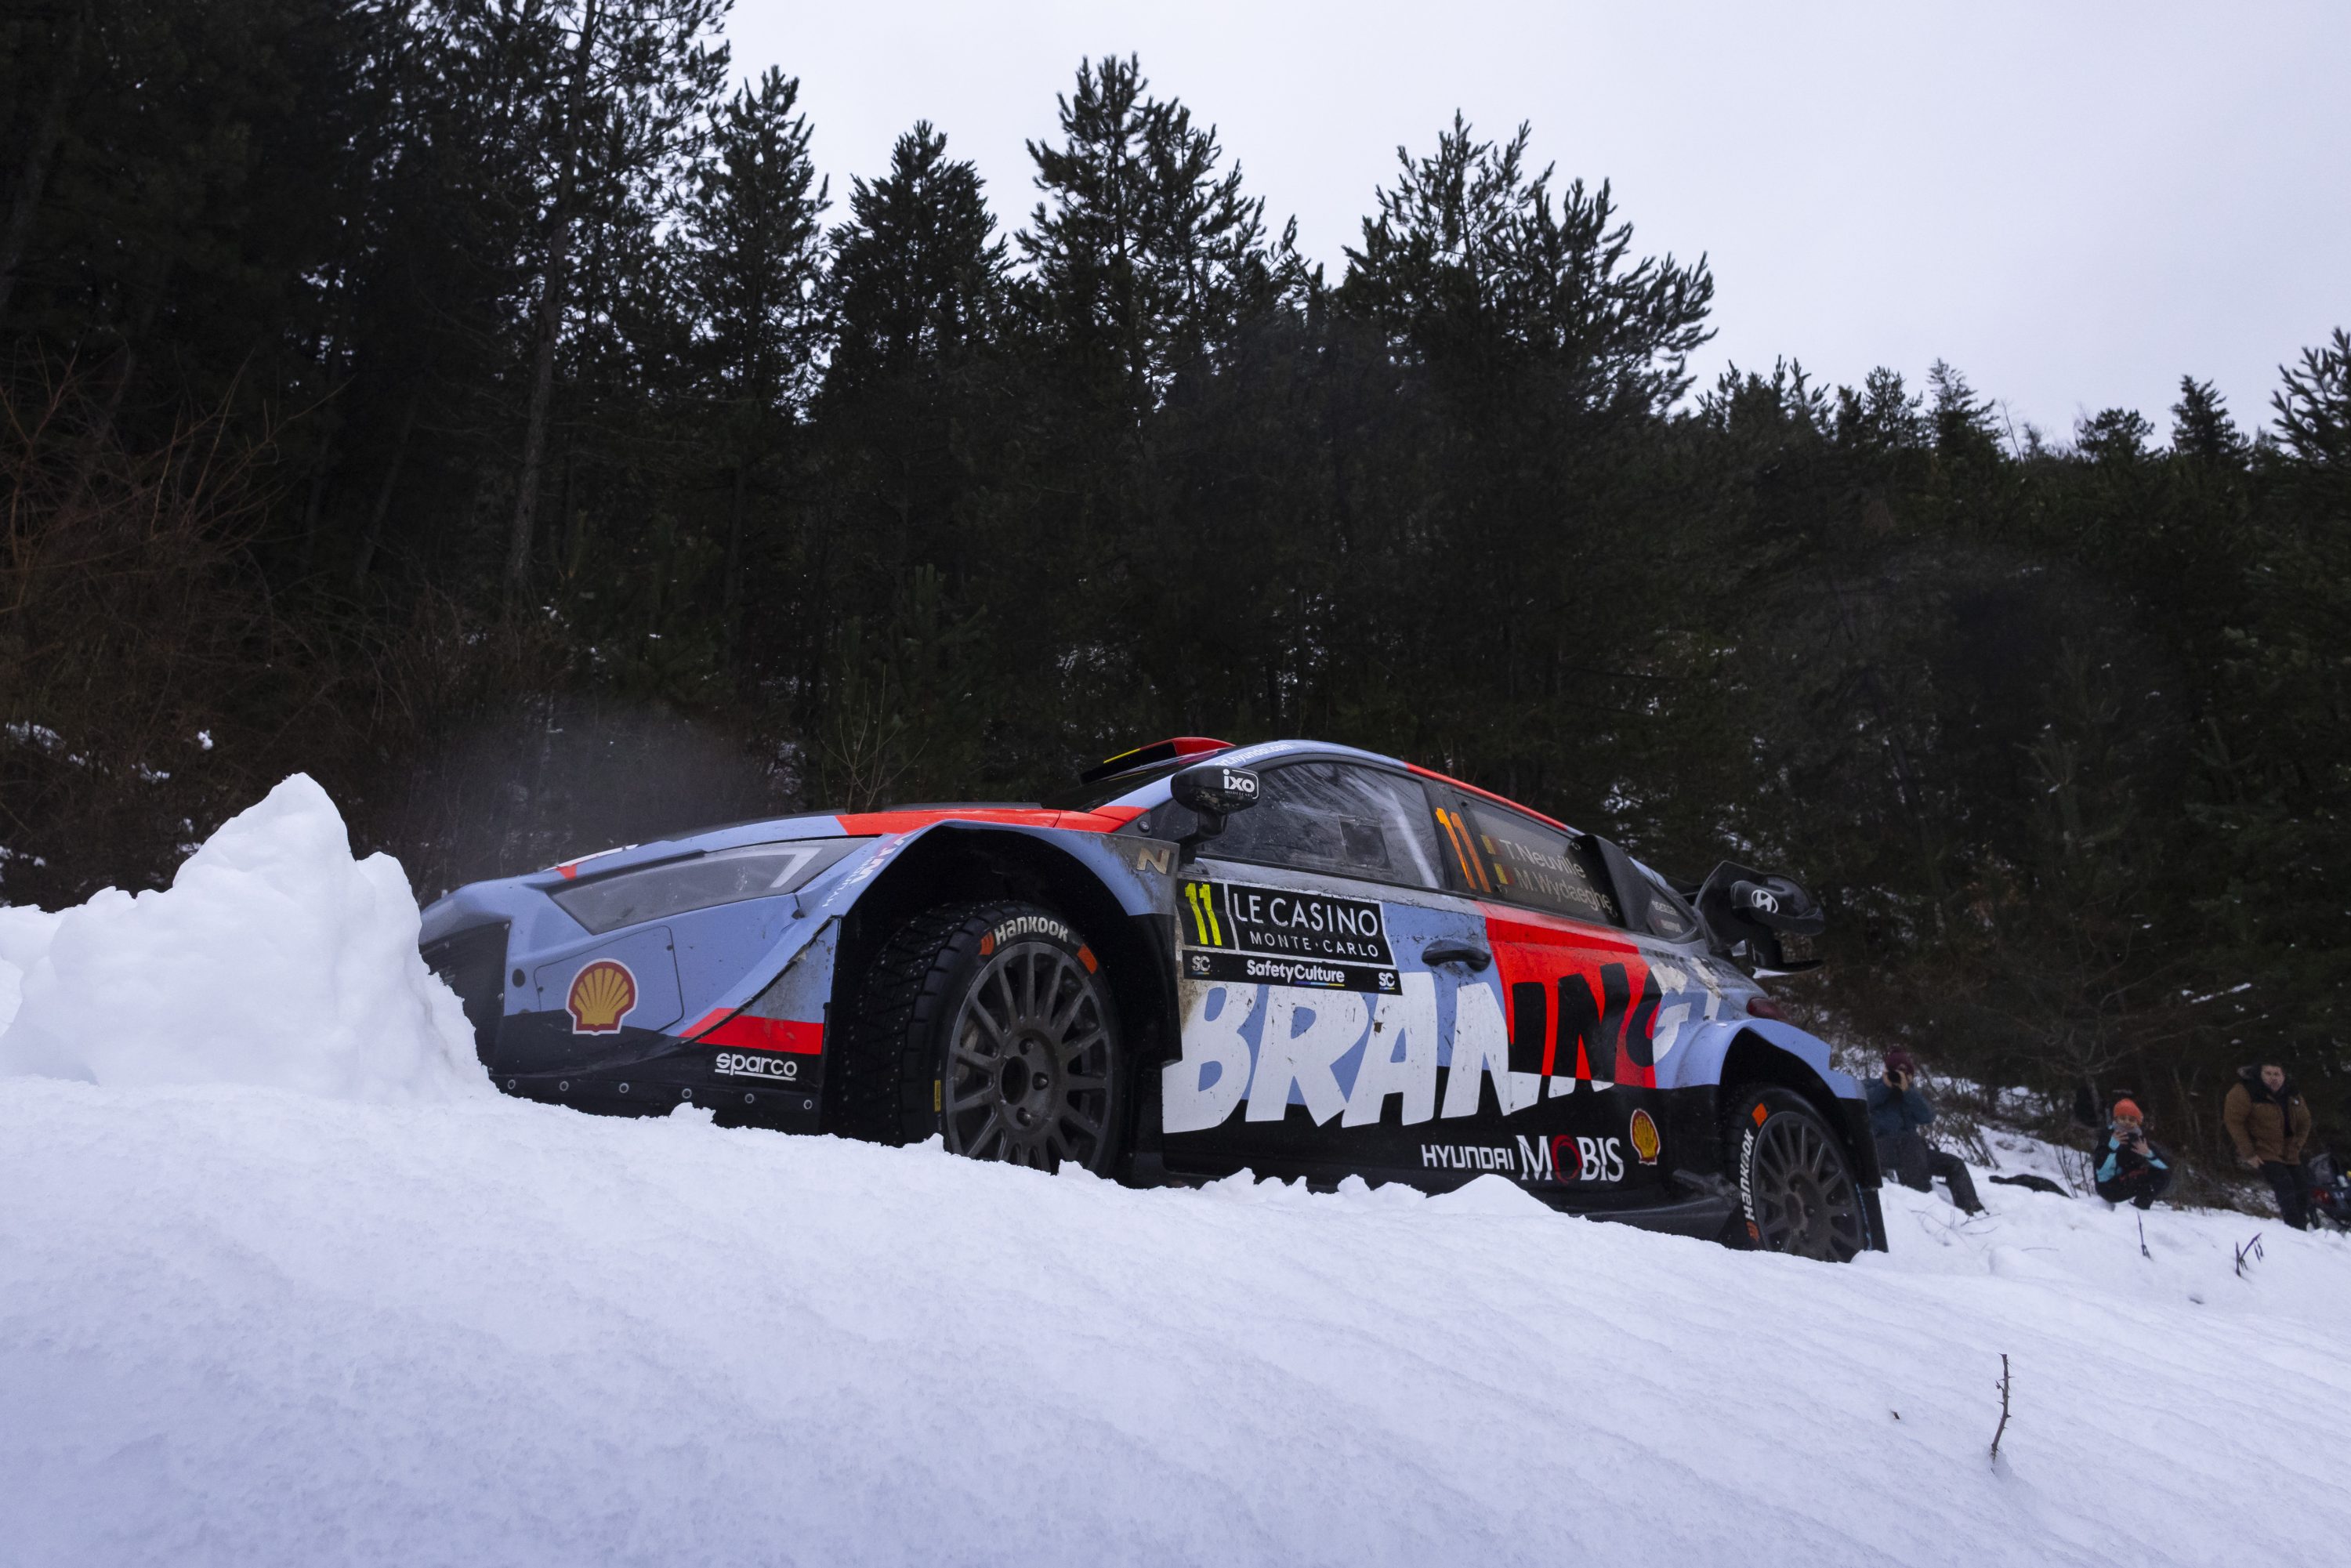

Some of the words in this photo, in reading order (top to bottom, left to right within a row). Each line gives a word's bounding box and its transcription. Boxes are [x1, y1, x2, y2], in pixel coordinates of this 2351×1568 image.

[1136, 847, 1170, 875] N
[1436, 807, 1491, 893] 11
[1498, 838, 1587, 878] T.Neuville
[1185, 883, 1222, 946] 11
[1233, 893, 1264, 925] LE
[1270, 897, 1379, 937] CASINO
[1246, 960, 1346, 984] SafetyCulture
[715, 1052, 798, 1081] sparco
[1421, 1143, 1516, 1171] HYUNDAI
[1516, 1135, 1625, 1185] MOBIS
